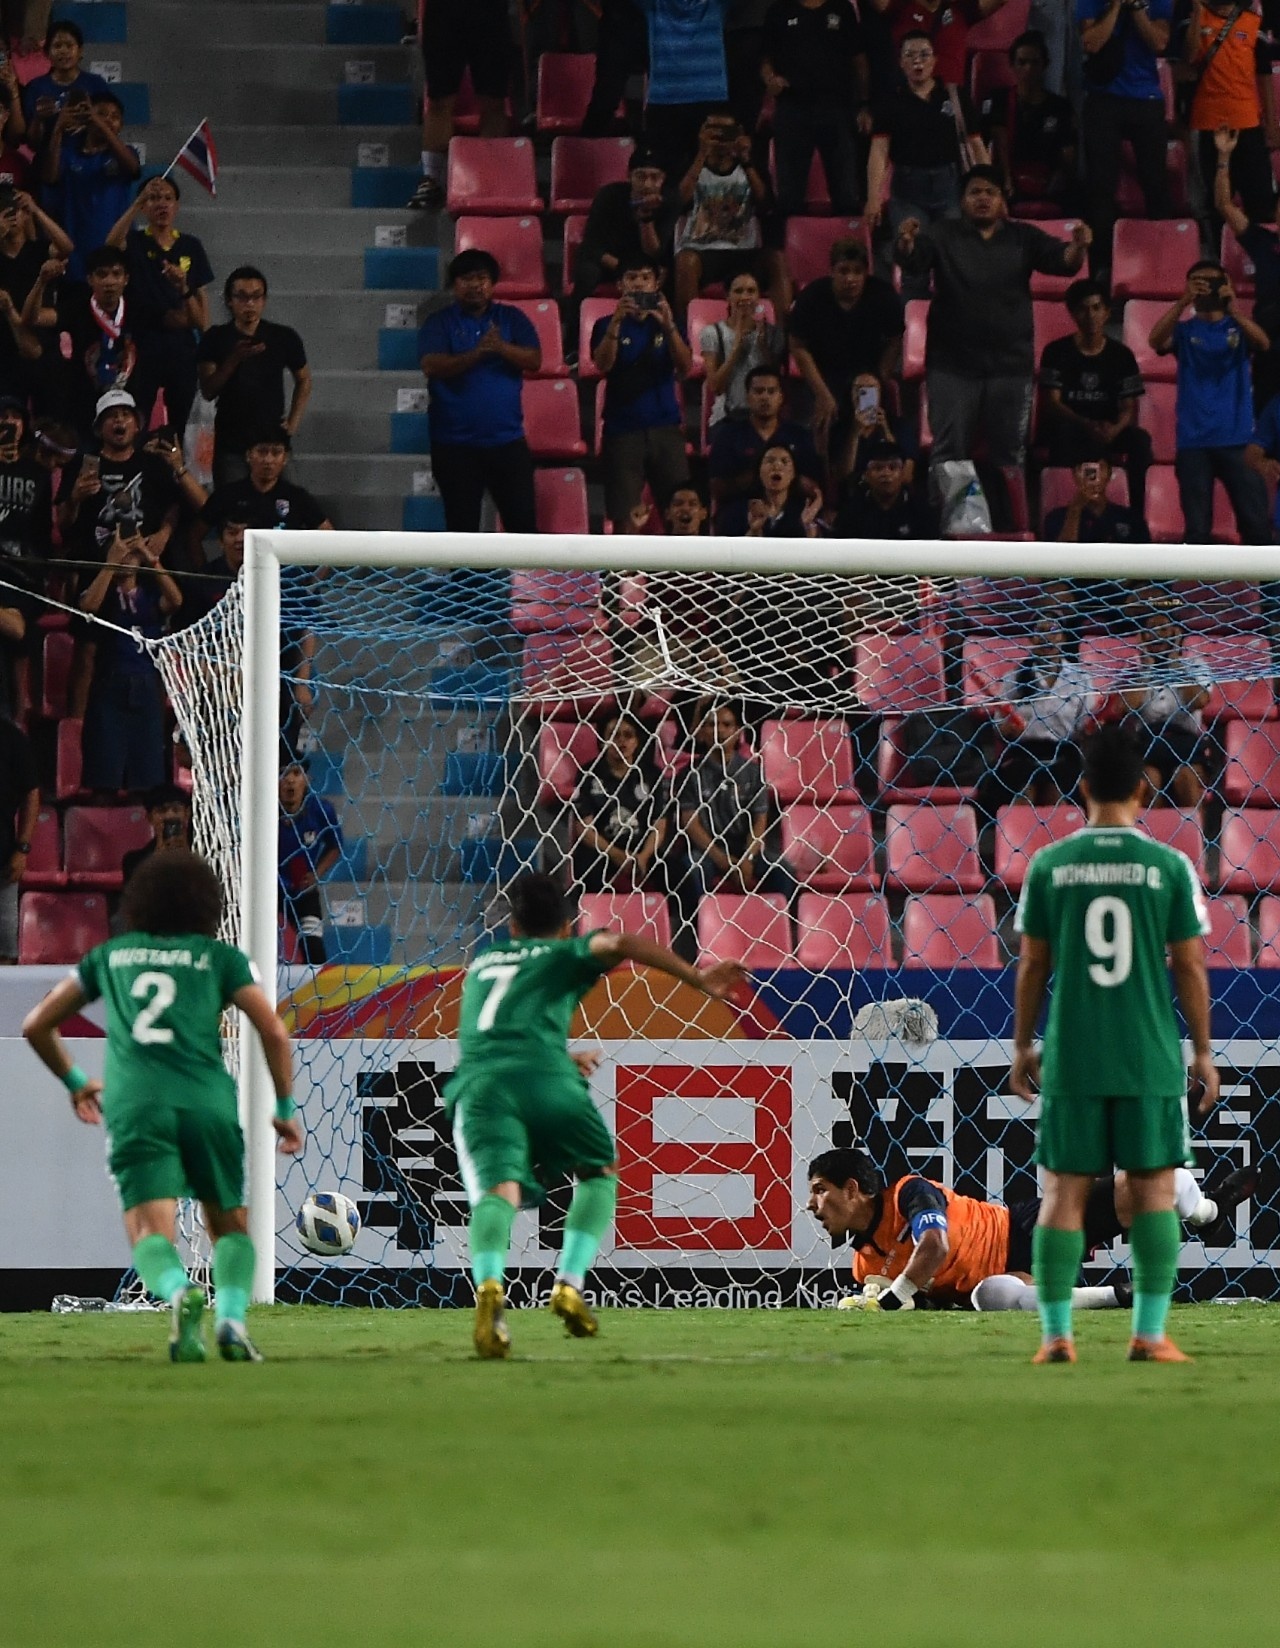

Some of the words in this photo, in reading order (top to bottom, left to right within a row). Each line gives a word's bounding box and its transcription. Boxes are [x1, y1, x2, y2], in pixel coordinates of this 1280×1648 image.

[1052, 863, 1145, 888] MOHAMMED
[1084, 895, 1133, 987] 9
[130, 971, 177, 1045] 2
[477, 965, 521, 1032] 7
[520, 1282, 641, 1309] Jaan's
